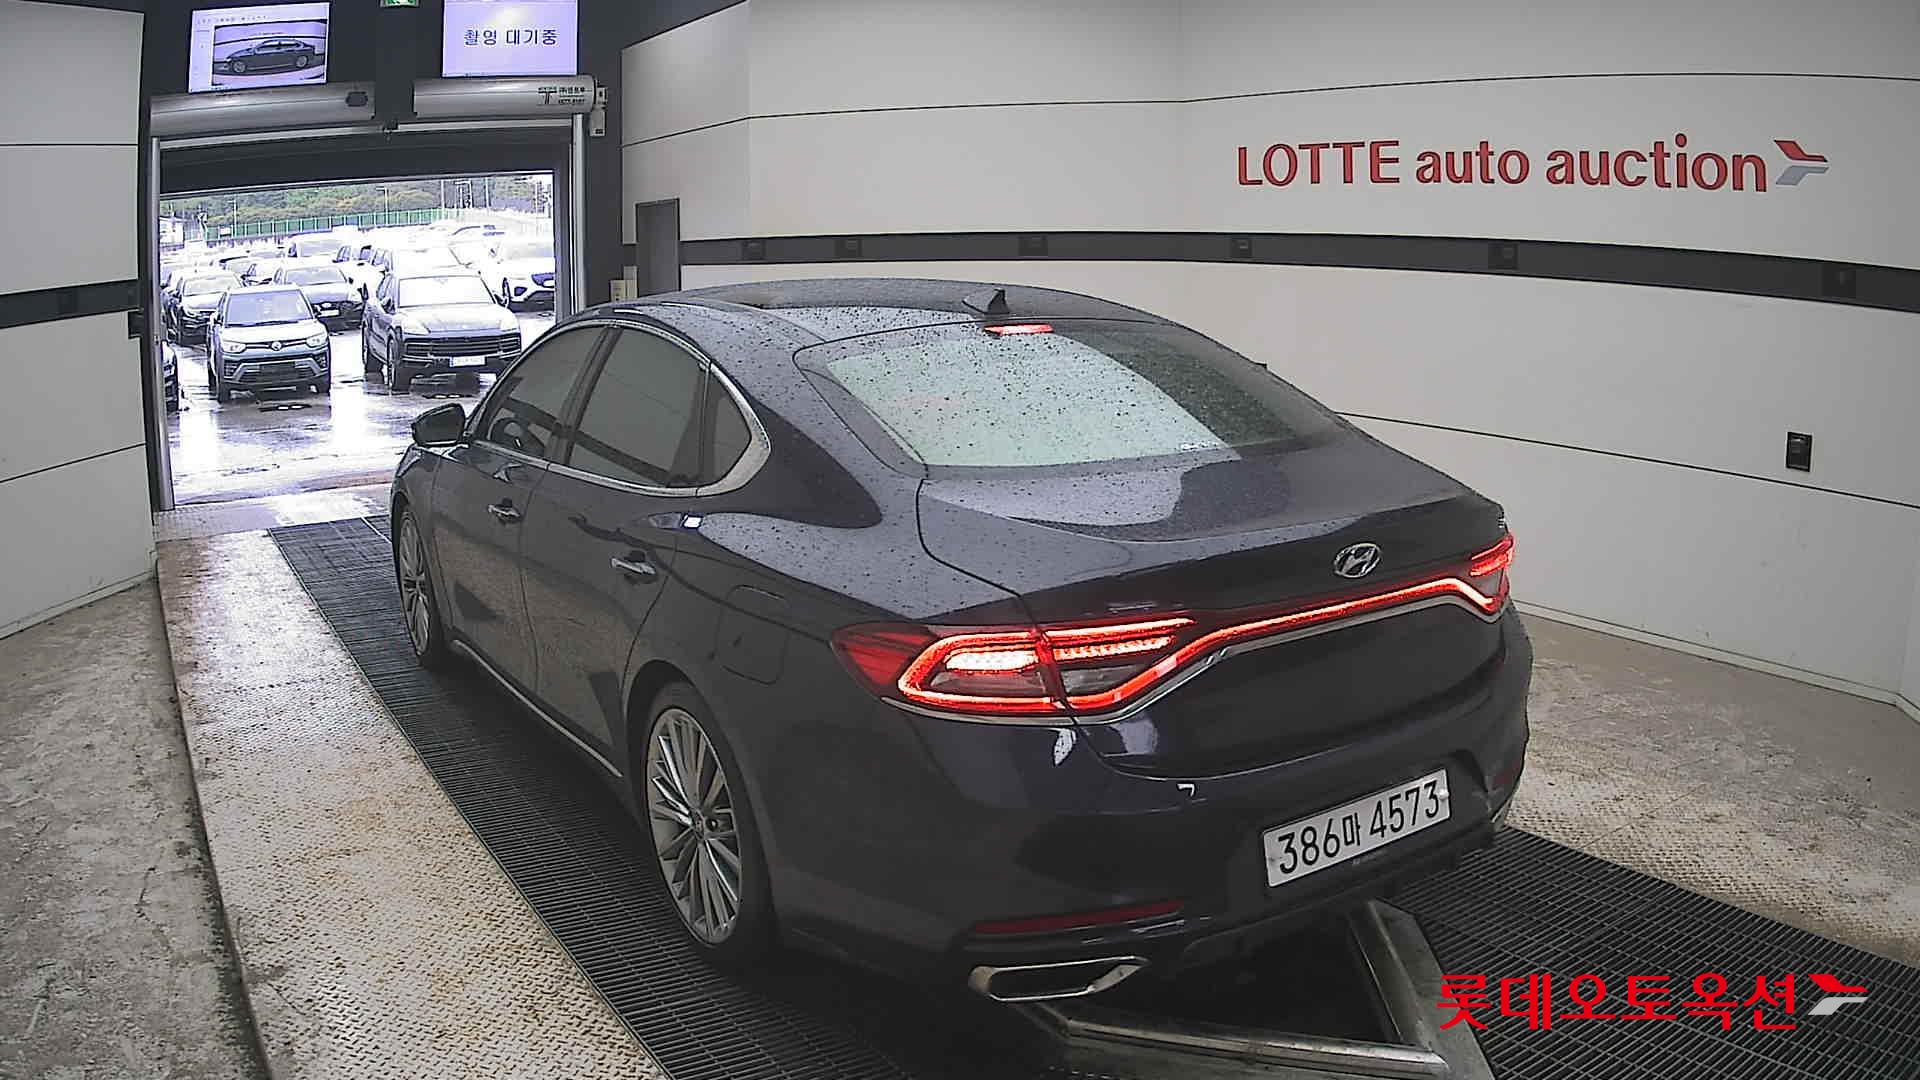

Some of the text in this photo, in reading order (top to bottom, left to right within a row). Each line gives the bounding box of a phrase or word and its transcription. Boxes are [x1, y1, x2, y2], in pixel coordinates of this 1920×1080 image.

[464, 29, 557, 46] 촬영 대기중
[1237, 133, 1768, 193] LOTTE auto auction
[1277, 779, 1440, 874] 386마 4573
